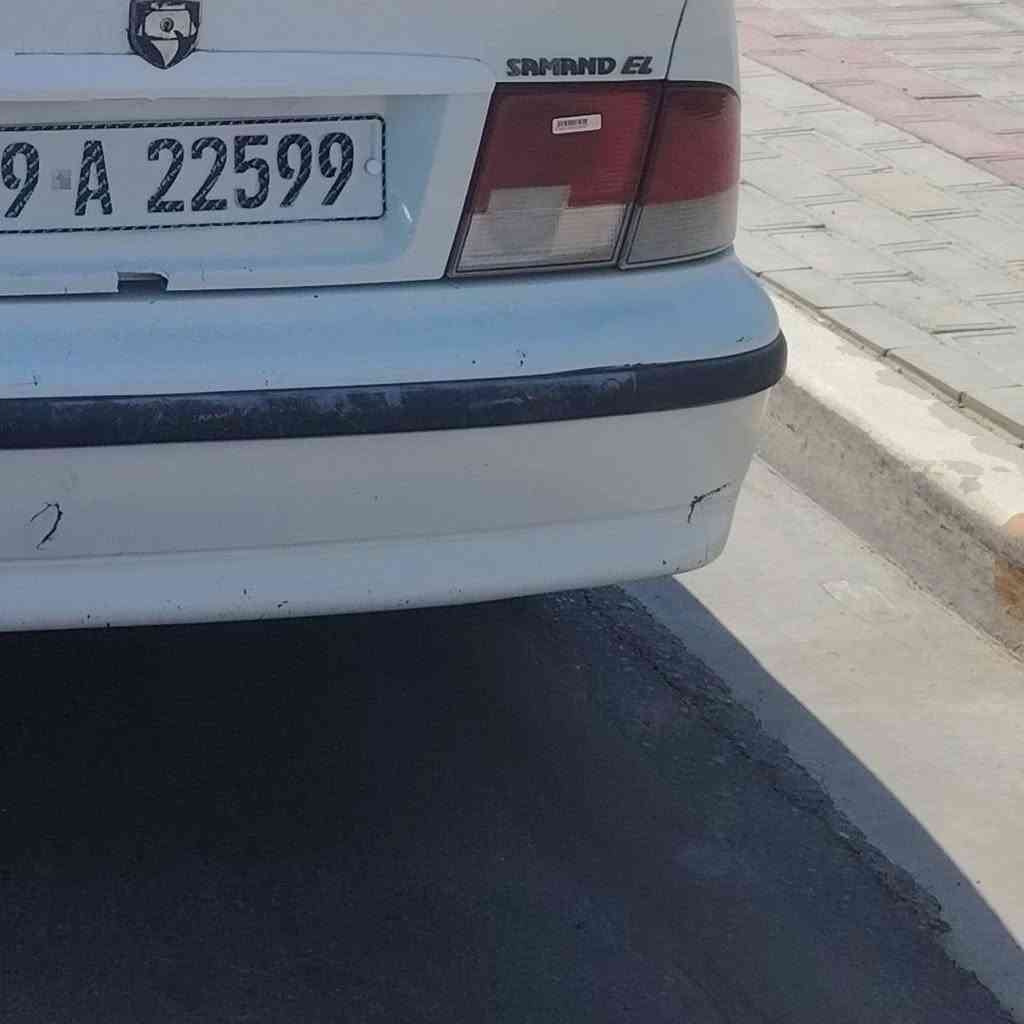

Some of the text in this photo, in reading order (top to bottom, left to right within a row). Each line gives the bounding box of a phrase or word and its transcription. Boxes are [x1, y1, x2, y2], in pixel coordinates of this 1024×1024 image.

[506, 57, 617, 77] SAMAND
[75, 139, 113, 217] A
[147, 131, 355, 213] 22599
